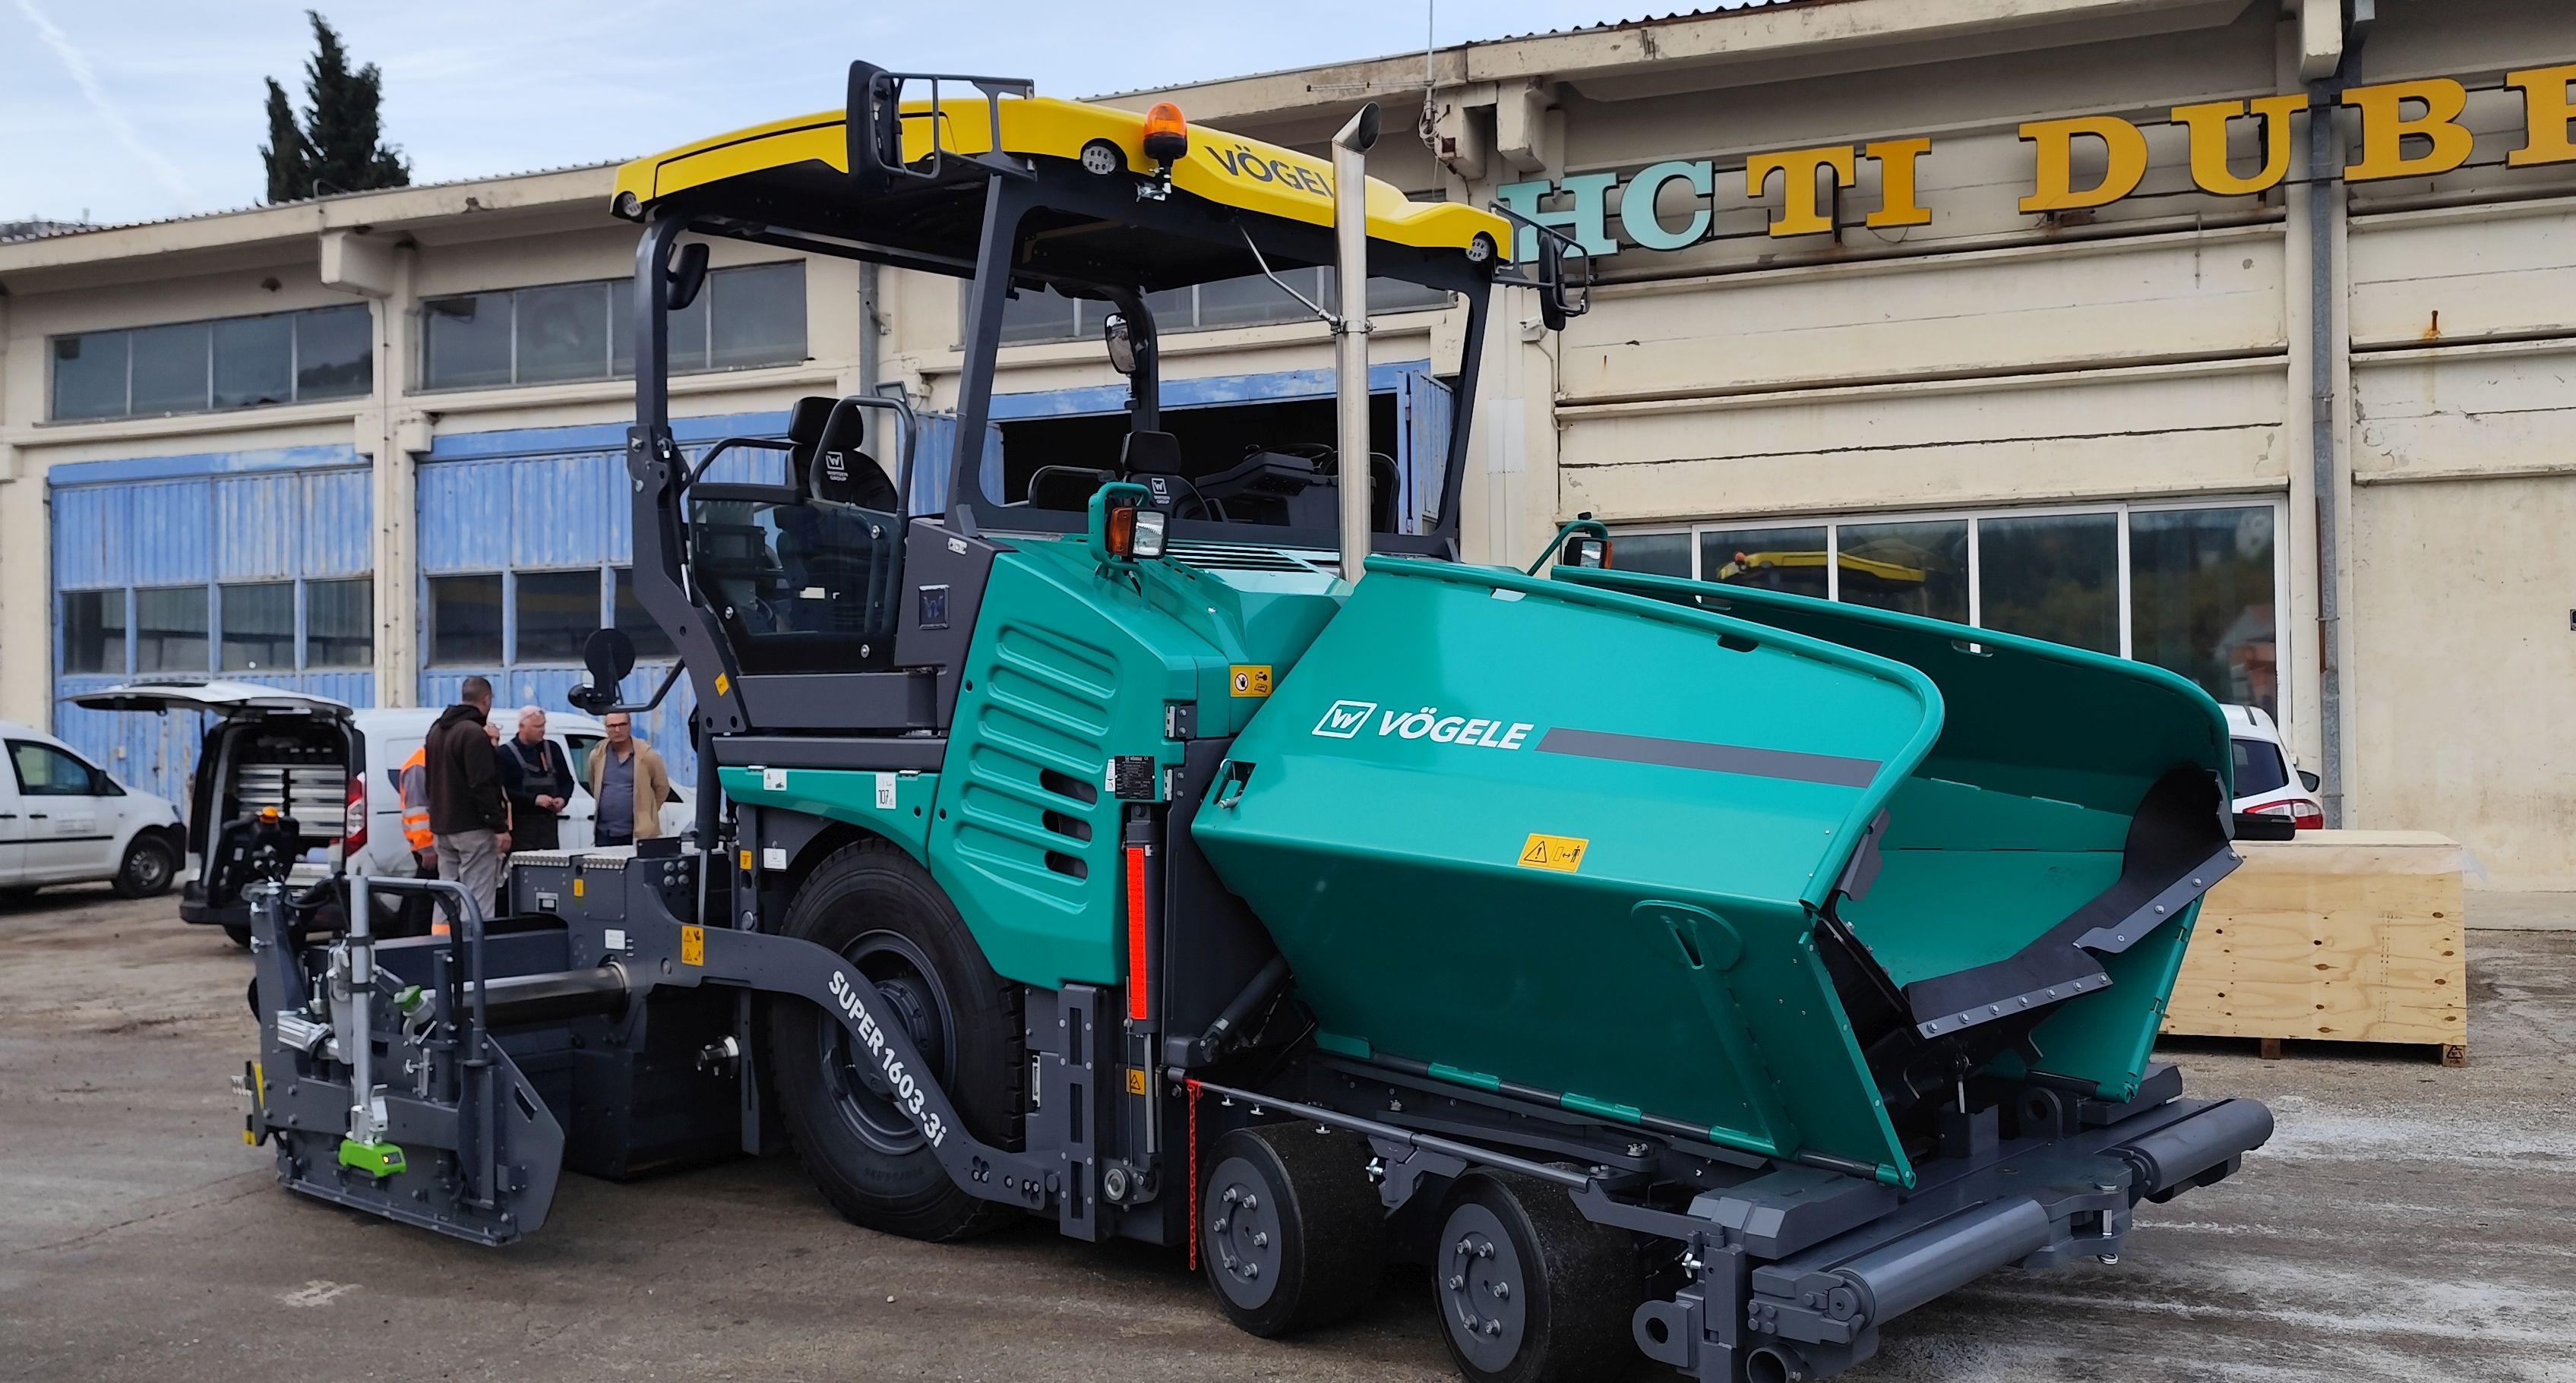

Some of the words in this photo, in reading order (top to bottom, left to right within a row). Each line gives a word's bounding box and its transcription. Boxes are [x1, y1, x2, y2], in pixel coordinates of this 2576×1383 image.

[1204, 144, 1334, 197] VÖGEL
[1378, 706, 1535, 750] VÖGELE
[828, 970, 885, 1057] SUPER
[881, 1047, 949, 1149] 1603-3i
